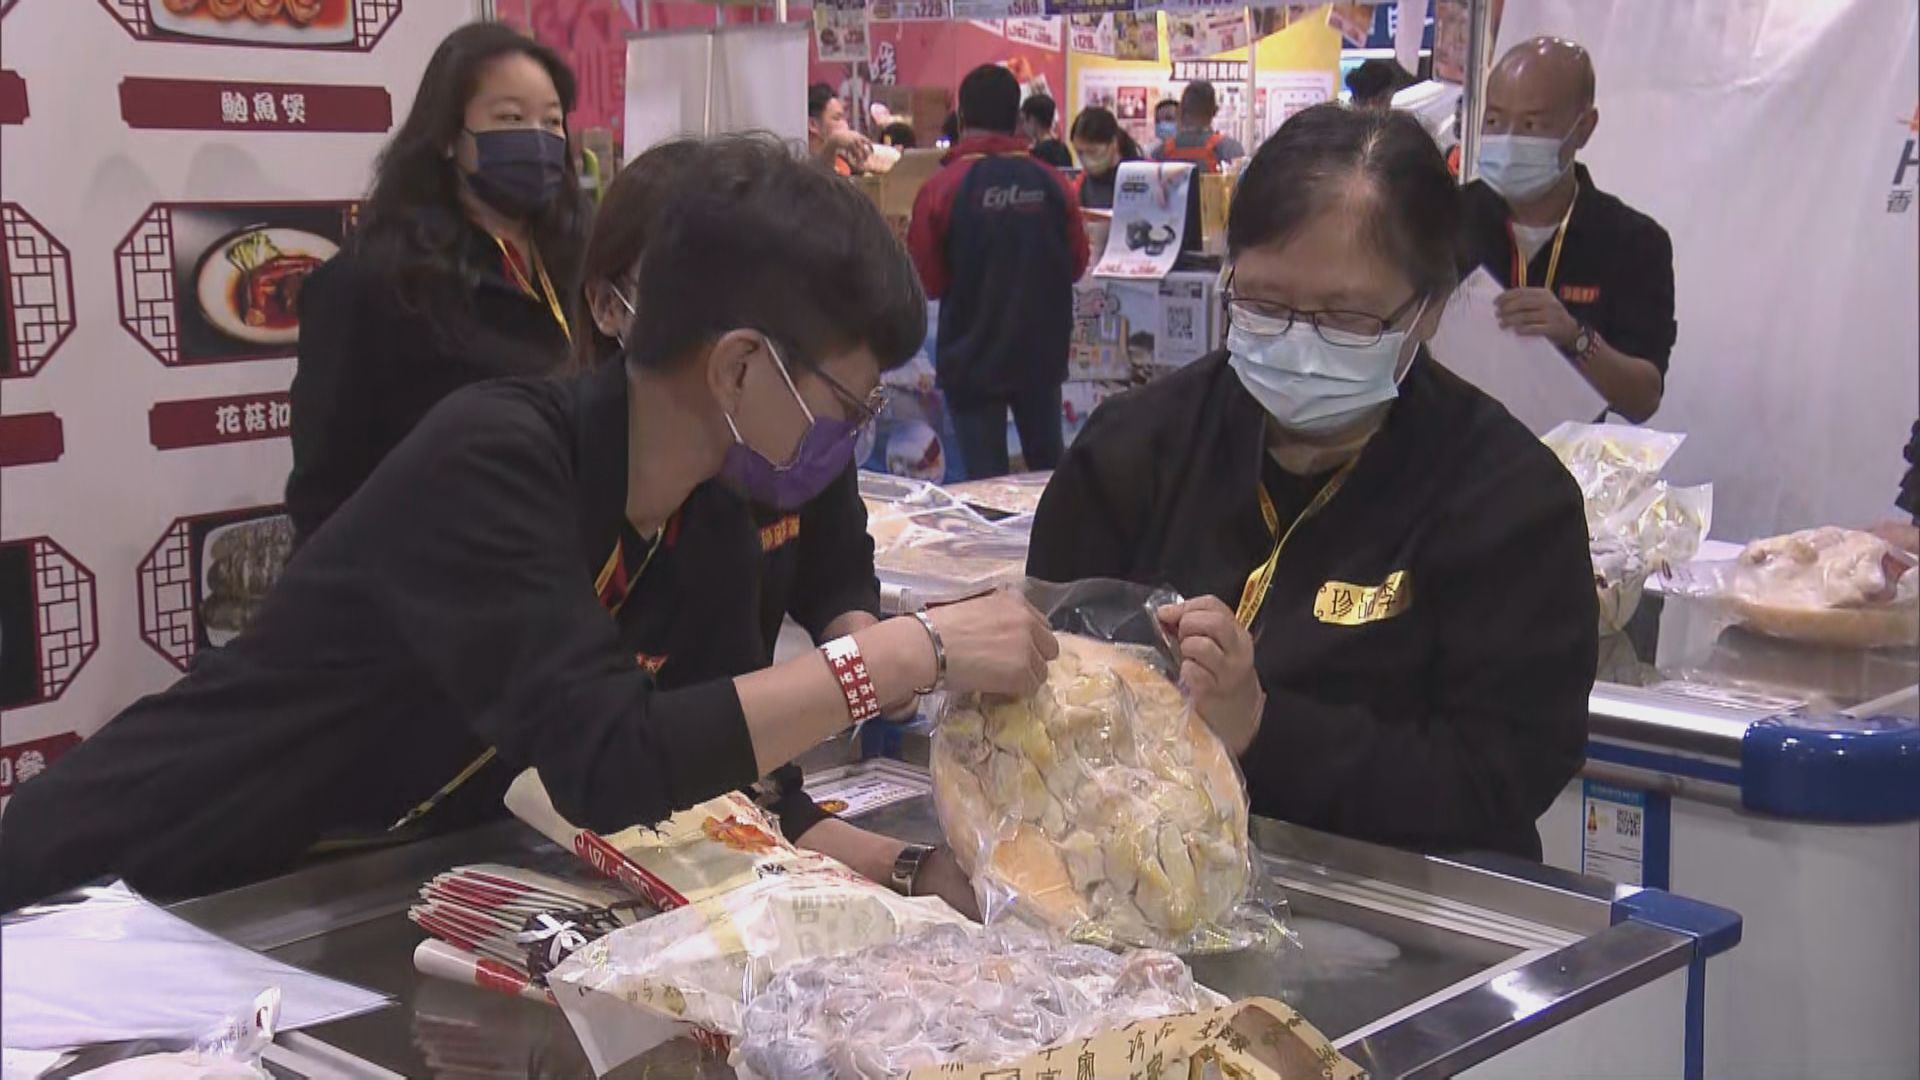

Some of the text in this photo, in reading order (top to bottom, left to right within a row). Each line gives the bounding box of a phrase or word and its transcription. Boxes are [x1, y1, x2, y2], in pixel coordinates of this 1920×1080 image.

[221, 91, 306, 123] 鮑魚煲
[215, 401, 291, 435] 花菇扣
